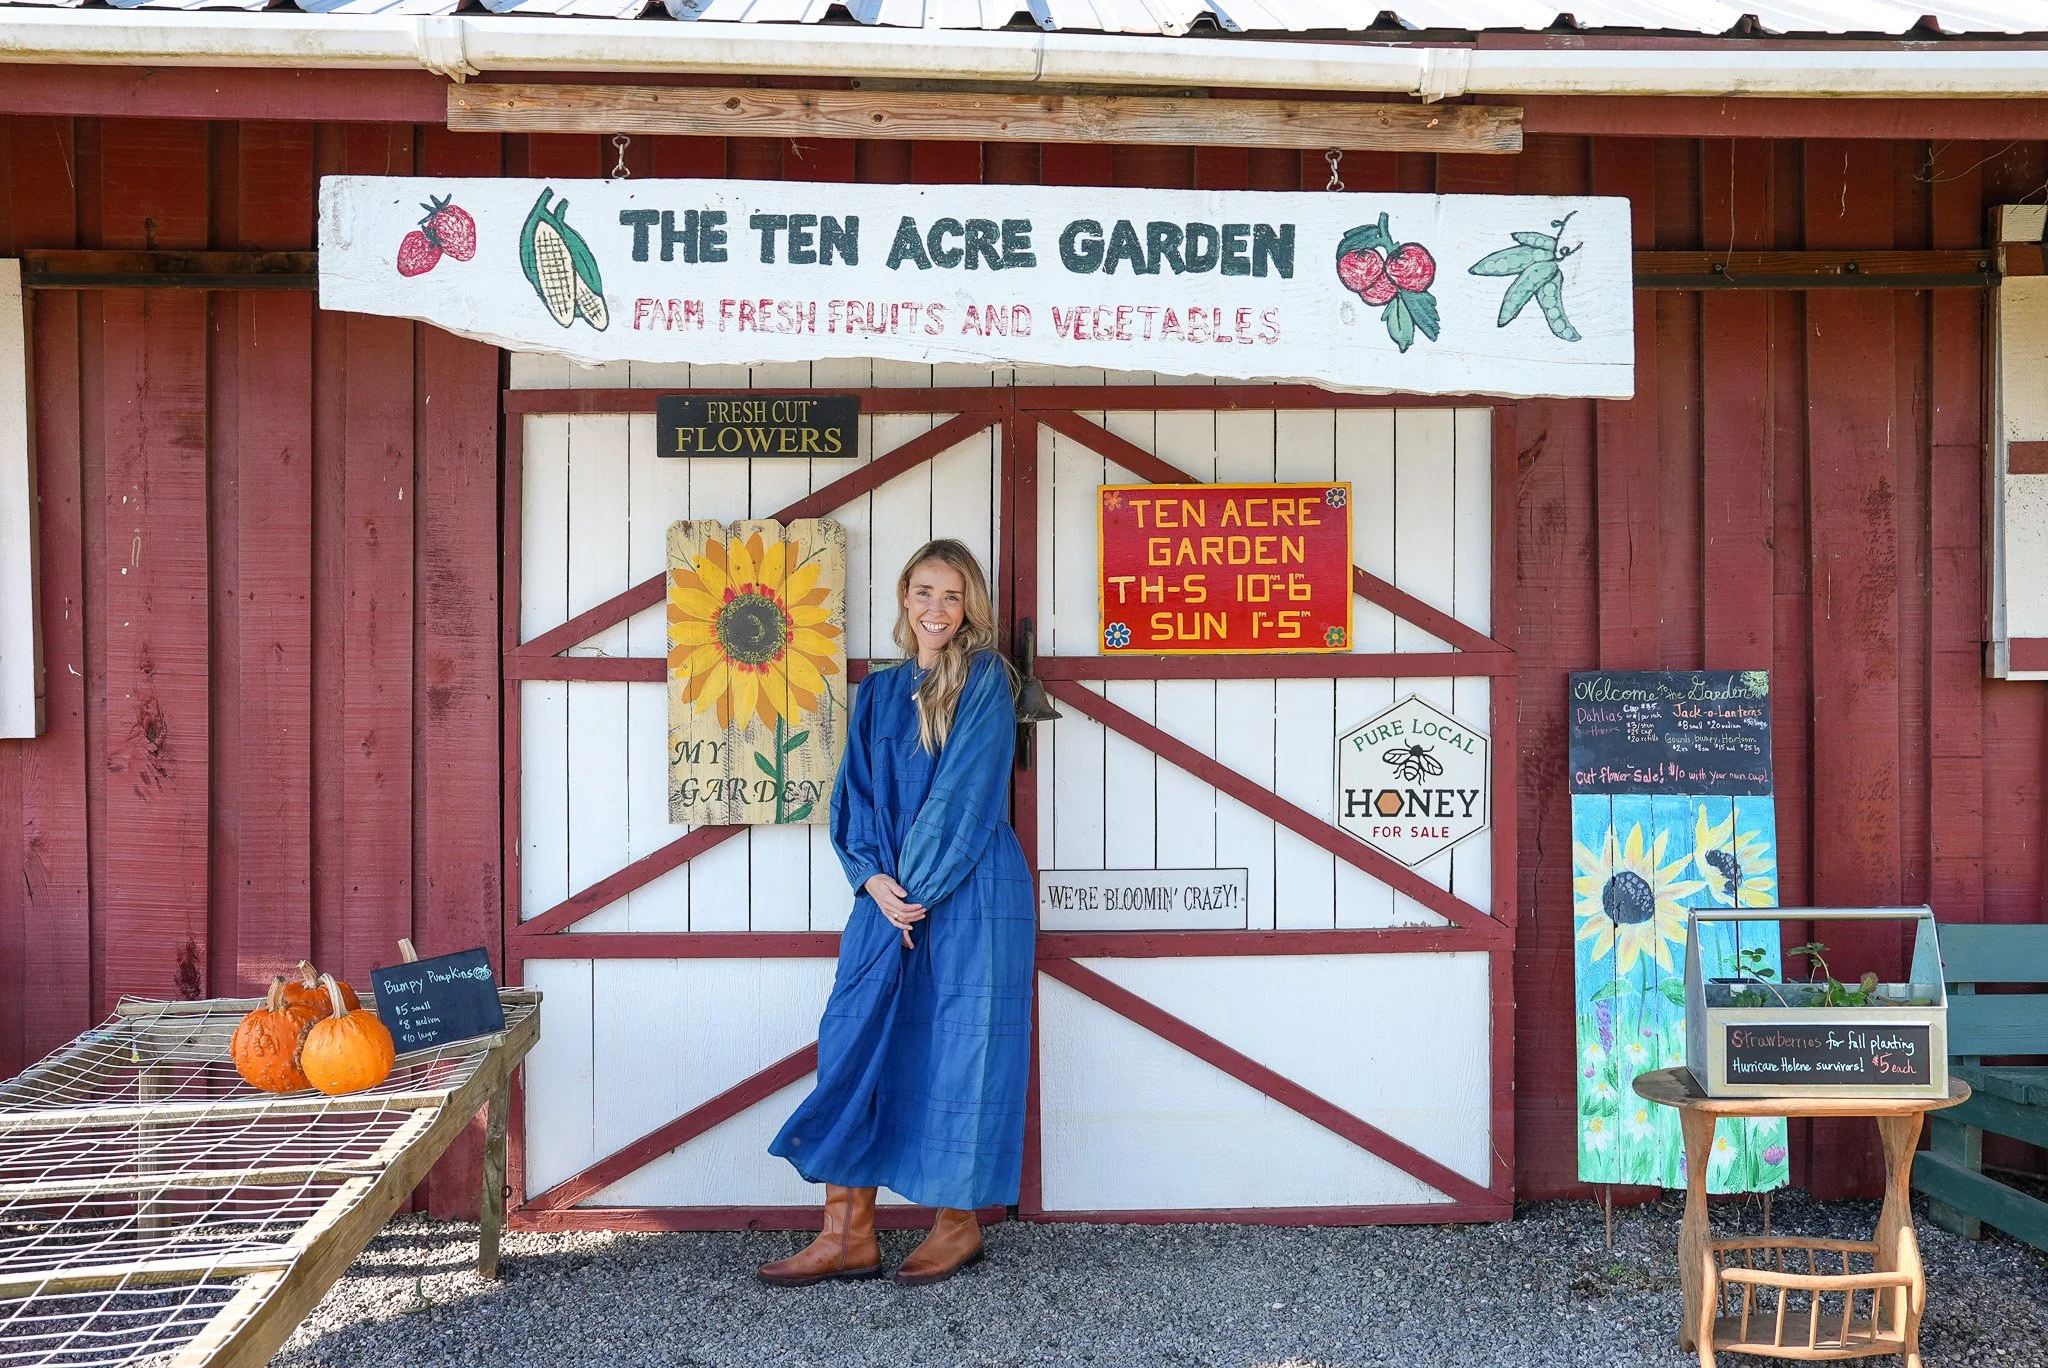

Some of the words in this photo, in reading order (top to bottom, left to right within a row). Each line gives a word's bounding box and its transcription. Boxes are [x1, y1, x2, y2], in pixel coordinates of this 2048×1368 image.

[620, 209, 728, 263] THE
[750, 214, 859, 266] TEN
[886, 215, 1037, 271] ACRE
[1059, 219, 1295, 278] GARDEN
[634, 297, 705, 332] FARM
[719, 298, 816, 334] FRESH
[828, 298, 945, 336] FRUITS
[961, 303, 1032, 337] AND
[1053, 305, 1280, 344] VEGETABLES
[707, 400, 767, 423] FRESH
[772, 400, 811, 423] CUT
[675, 427, 842, 453] FLOWERS
[1129, 499, 1206, 528] TEN
[1221, 498, 1321, 527] ACRE
[1148, 536, 1304, 566] GARDEN
[1108, 574, 1207, 604] TH-S
[1151, 612, 1227, 640] SUN
[1574, 677, 1659, 701] Welcome
[1657, 682, 1668, 696] to
[1665, 687, 1685, 700] the
[1688, 675, 1751, 701] Garden
[1577, 707, 1622, 724] Dahlias
[1678, 720, 1688, 730] $8
[1353, 720, 1404, 752] PURE
[1412, 719, 1474, 754] LOCAL
[672, 739, 727, 765] MY
[1599, 765, 1631, 784] flower
[1689, 768, 1707, 781] with
[1710, 769, 1726, 785] your
[1730, 773, 1746, 781] own
[1748, 769, 1769, 782] cup!
[675, 778, 825, 807] GARDEN
[1345, 789, 1479, 817] HONEY
[1373, 826, 1401, 838] FOR
[1411, 826, 1449, 838] SALE
[1048, 886, 1099, 910] WE'RE
[1104, 887, 1178, 912] BLOOMIN'
[1184, 884, 1238, 911] CRAZY!
[384, 979, 423, 995] Bumpy
[427, 965, 473, 983] Pumpkins
[395, 1003, 408, 1016] $5
[411, 1001, 431, 1013] small
[399, 1020, 410, 1029] $8
[416, 1016, 441, 1026] medium
[402, 1034, 415, 1042] $10
[418, 1030, 438, 1041] large
[1731, 1029, 1822, 1048] Strawberries
[1825, 1031, 1845, 1050] for
[1849, 1031, 1866, 1050] fall
[1870, 1033, 1915, 1056] planting
[1732, 1057, 1780, 1073] Hurricane
[1781, 1057, 1812, 1072] Helene
[1816, 1057, 1865, 1072] survivors!
[1872, 1052, 1893, 1073] $5
[1891, 1059, 1917, 1074] each
